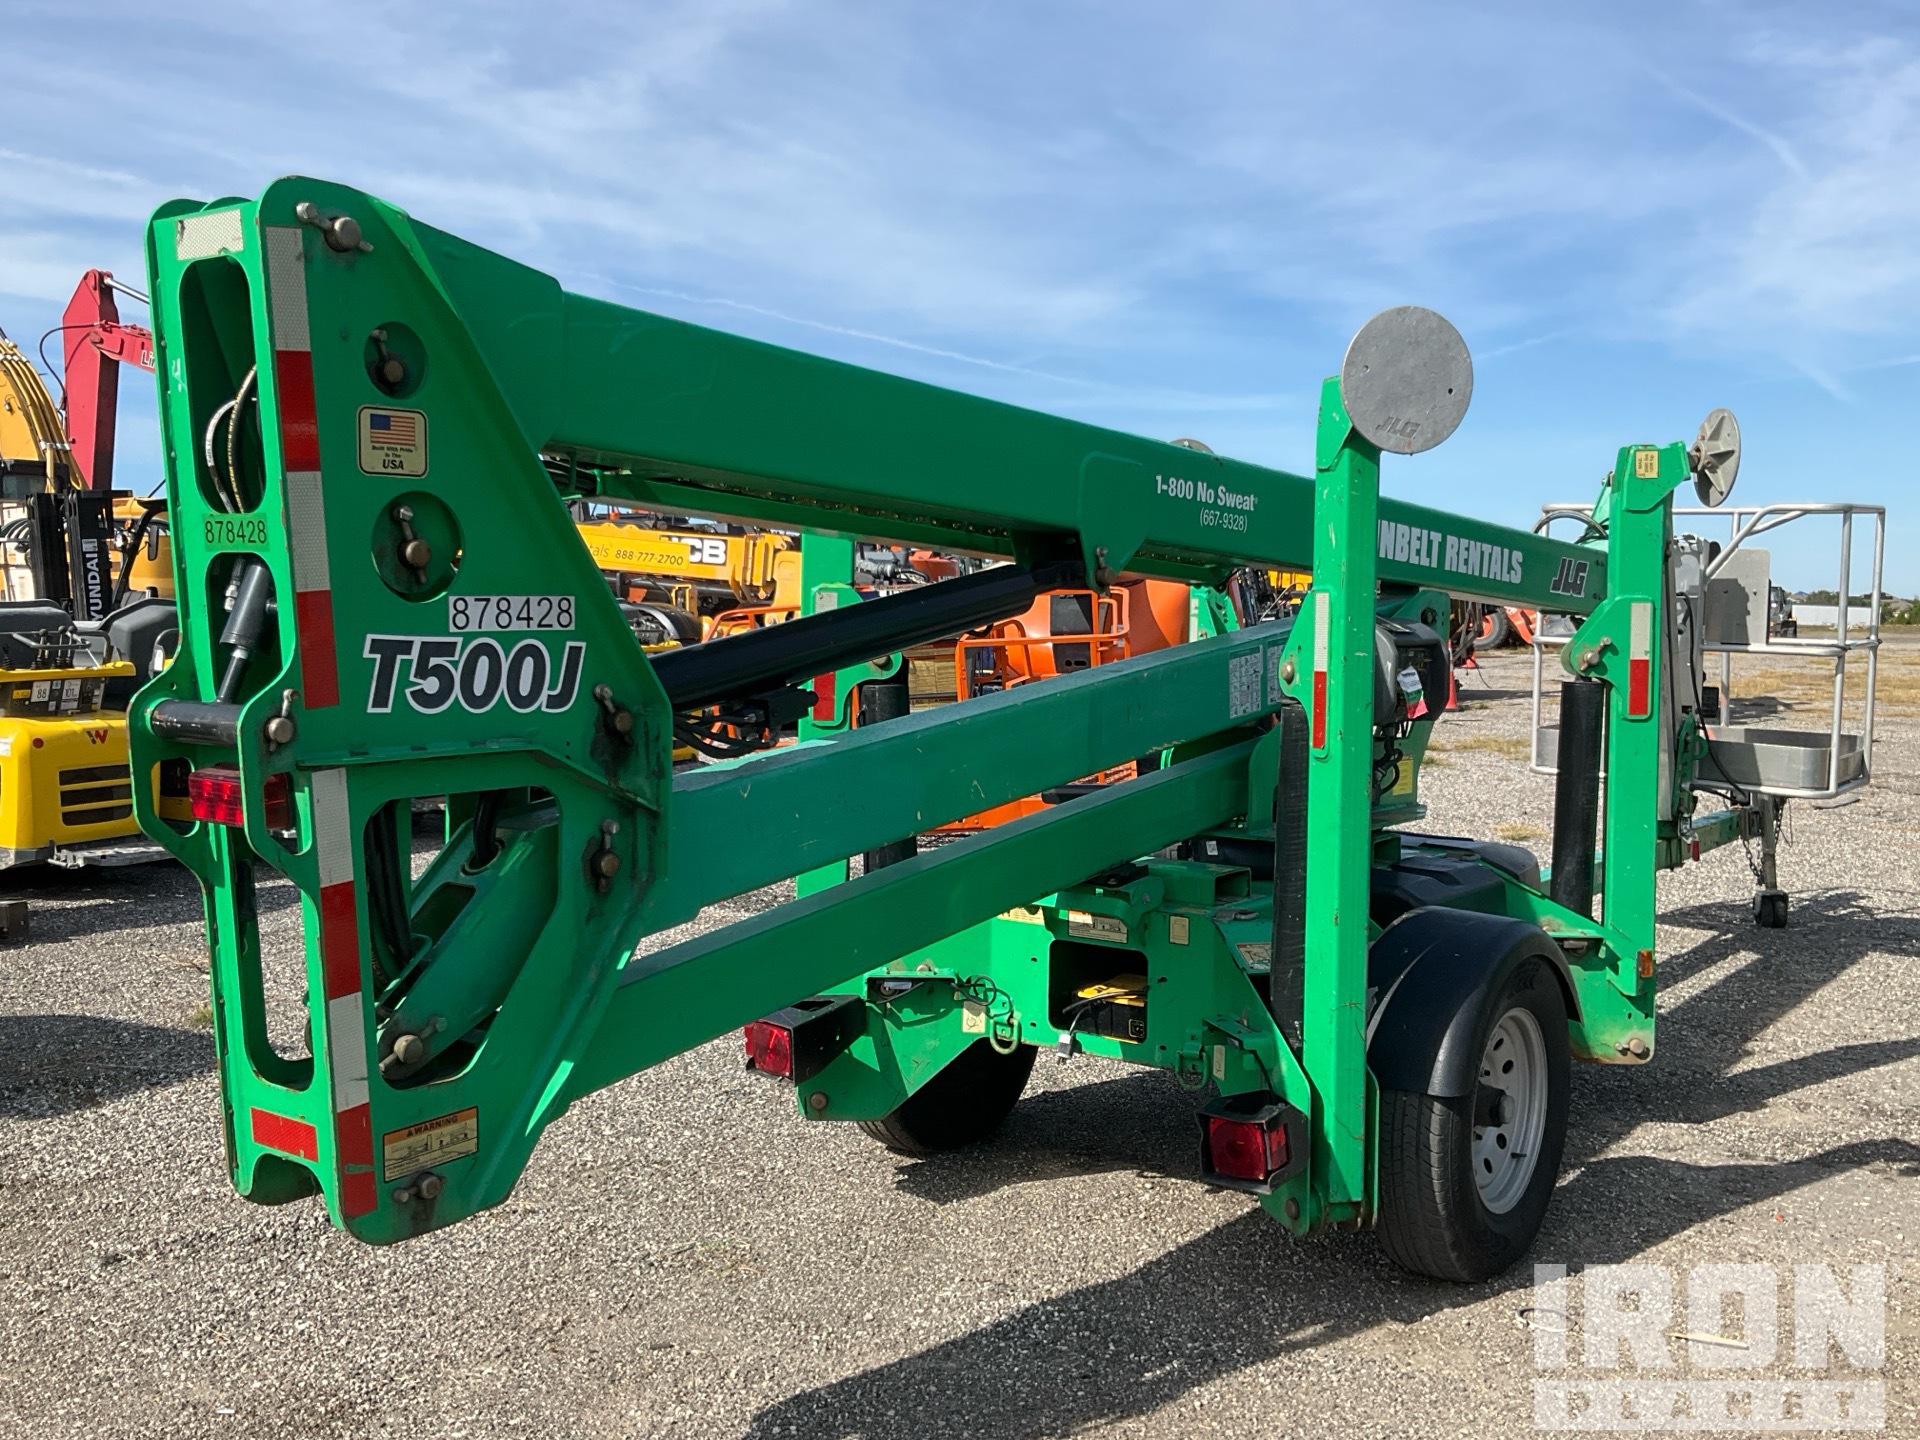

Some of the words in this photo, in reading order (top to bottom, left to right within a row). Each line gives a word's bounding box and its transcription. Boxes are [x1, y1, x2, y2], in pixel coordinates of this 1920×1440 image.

[1375, 416, 1421, 440] JLG
[382, 458, 404, 470] USA
[1155, 474, 1194, 500] 1-800
[1196, 481, 1214, 504] No
[205, 520, 267, 544] 878428
[1200, 506, 1248, 534] (667-9328)
[615, 549, 684, 566] 888-777-2700
[1378, 519, 1442, 568] NBELT
[1444, 534, 1523, 584] RENTALS
[1550, 556, 1590, 598] JLG
[452, 597, 573, 630] 878428
[363, 634, 587, 715] T500J
[413, 1115, 458, 1135] WARNING
